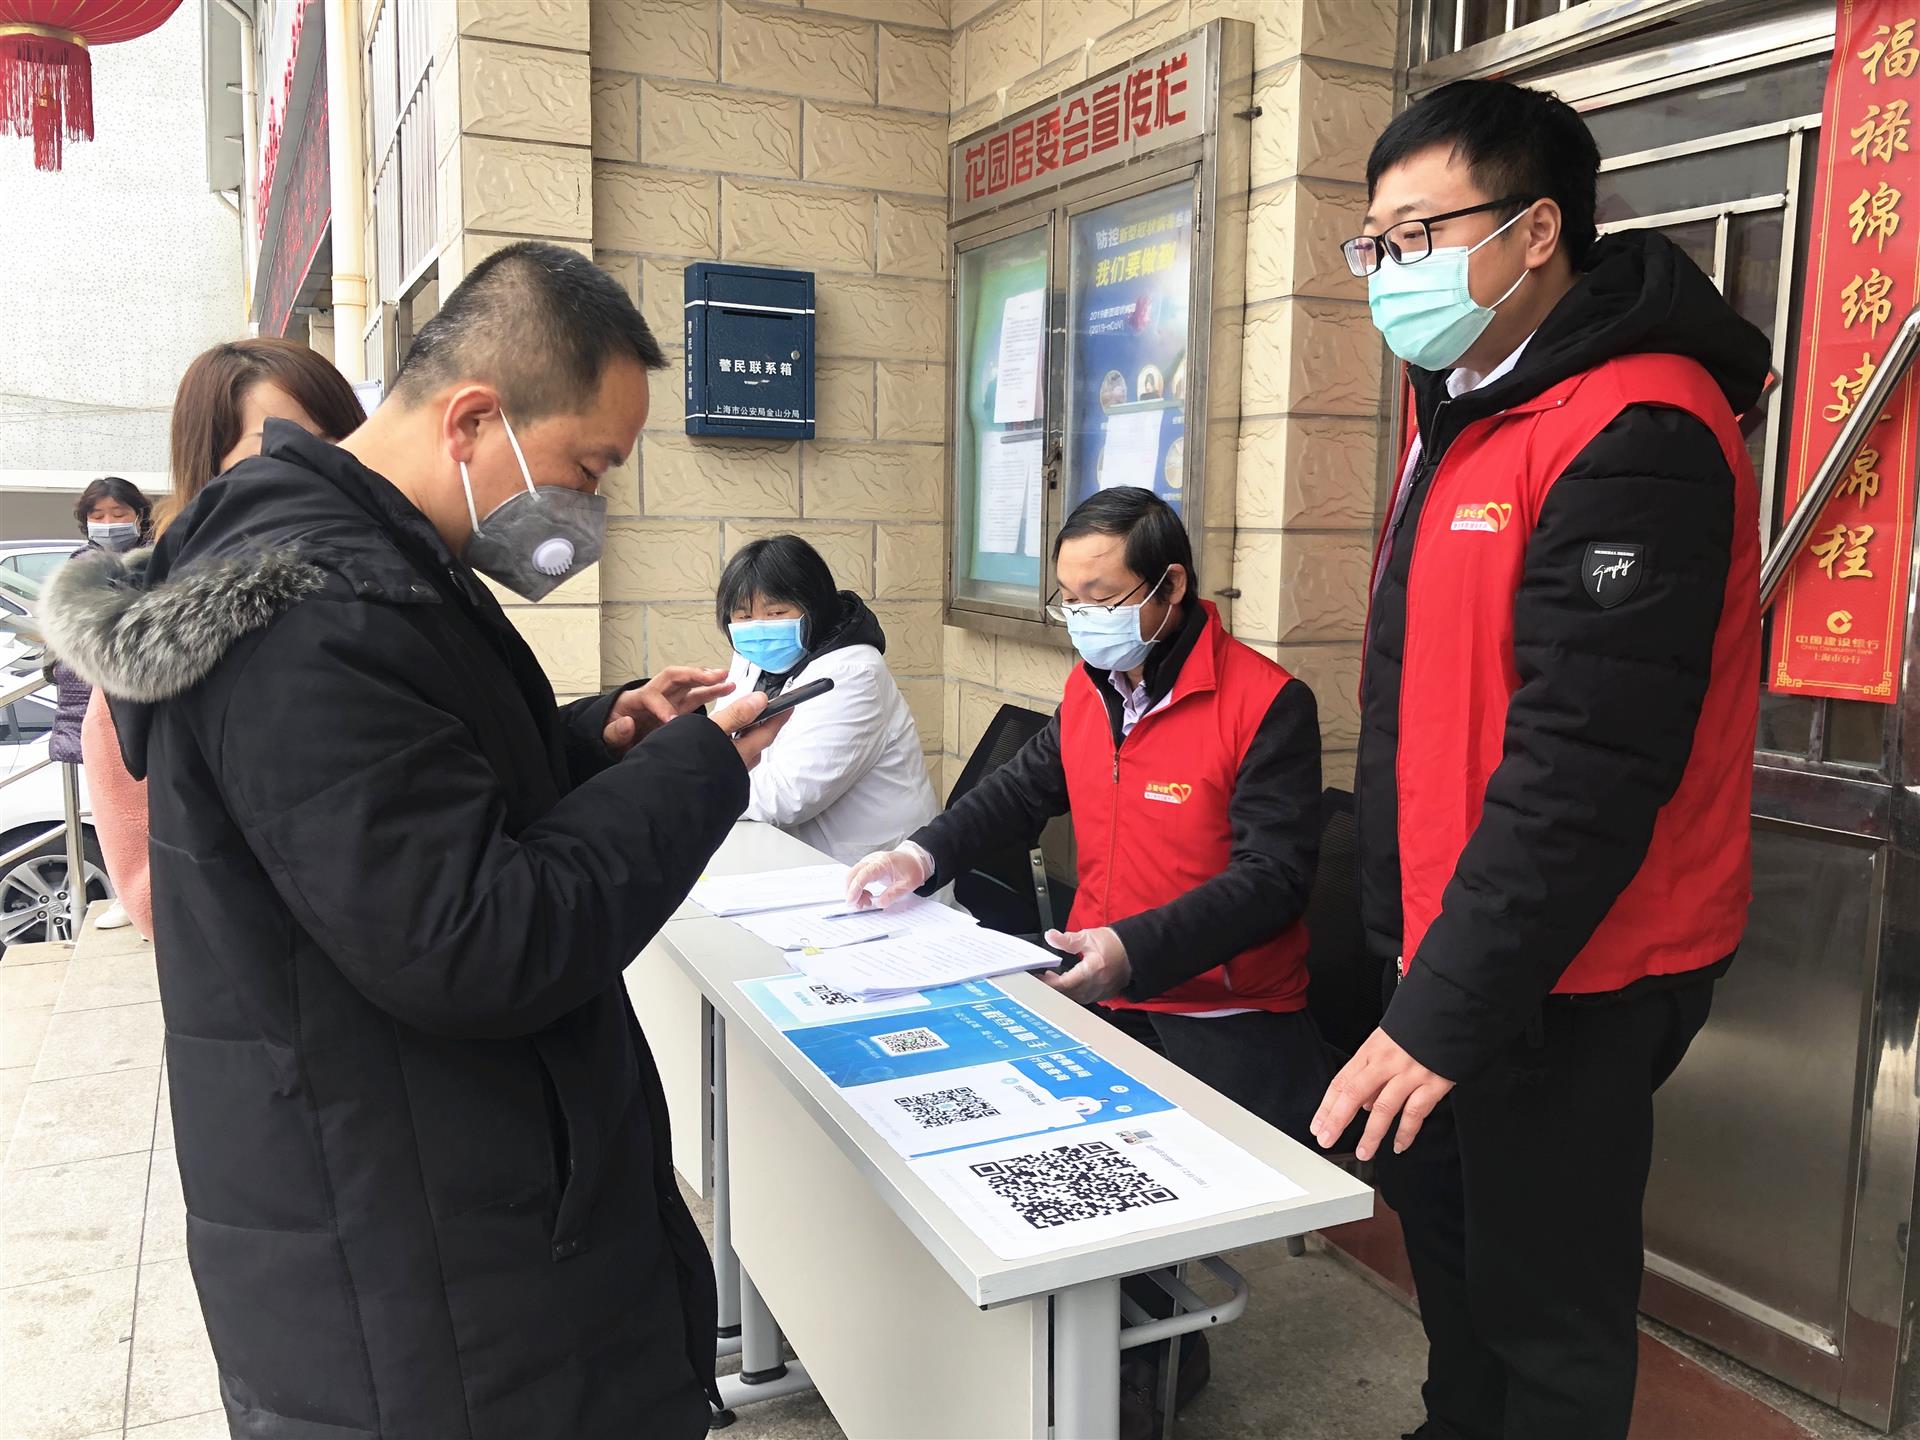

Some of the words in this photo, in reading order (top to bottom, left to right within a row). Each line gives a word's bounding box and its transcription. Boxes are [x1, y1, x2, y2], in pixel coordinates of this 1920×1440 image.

[964, 51, 1188, 203] 花园居委会宣传栏
[719, 359, 792, 376] 警民联系箱
[715, 405, 800, 418] 上海市公安局金山分局
[1796, 636, 1879, 649] 中国建设银行
[1815, 654, 1861, 664] 上海市分行
